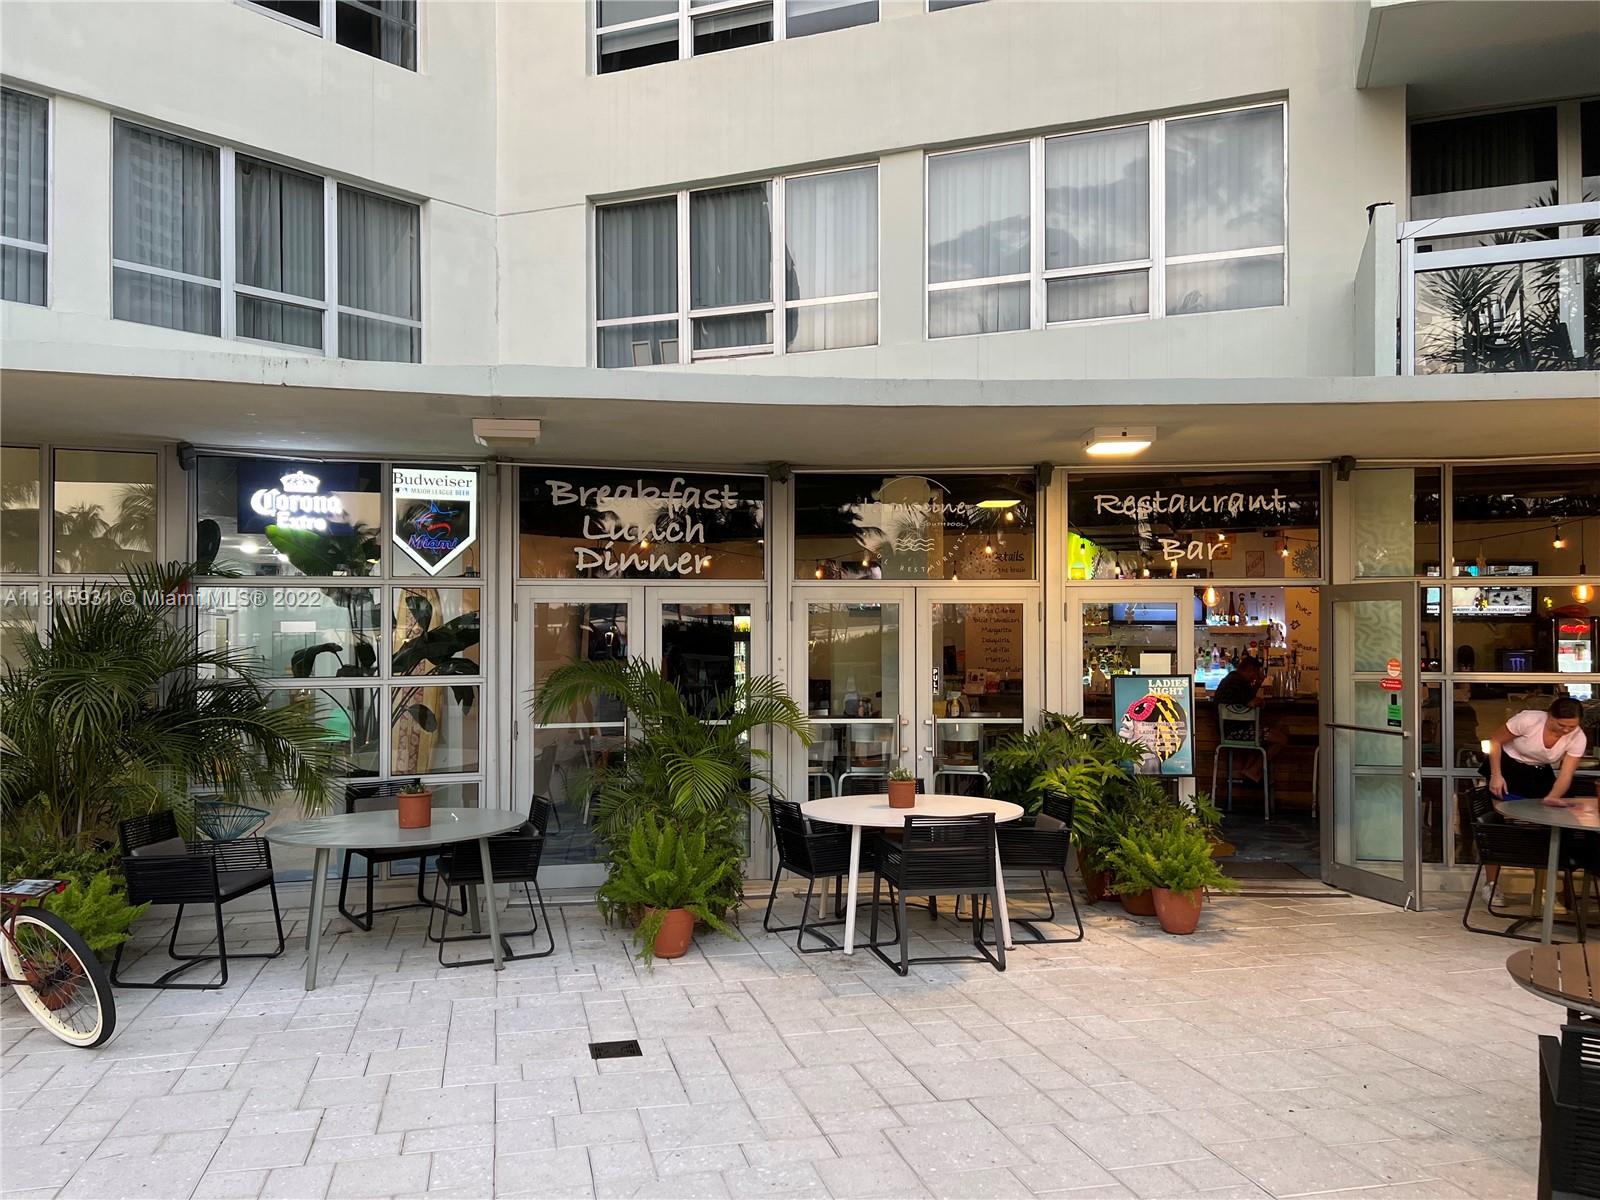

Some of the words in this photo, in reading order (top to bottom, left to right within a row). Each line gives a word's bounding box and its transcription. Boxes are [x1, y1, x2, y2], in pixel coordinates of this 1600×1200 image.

[393, 472, 473, 488] Budweiser
[250, 488, 343, 517] Corona
[545, 477, 739, 519] Breakfast
[1093, 488, 1287, 515] Restaurant
[408, 533, 458, 550] Miami
[583, 514, 705, 544] Lunch
[574, 541, 713, 575] Dinner
[1157, 537, 1229, 561] Bar
[1148, 679, 1189, 688] LADIES
[1149, 687, 1185, 695] NIGHT
